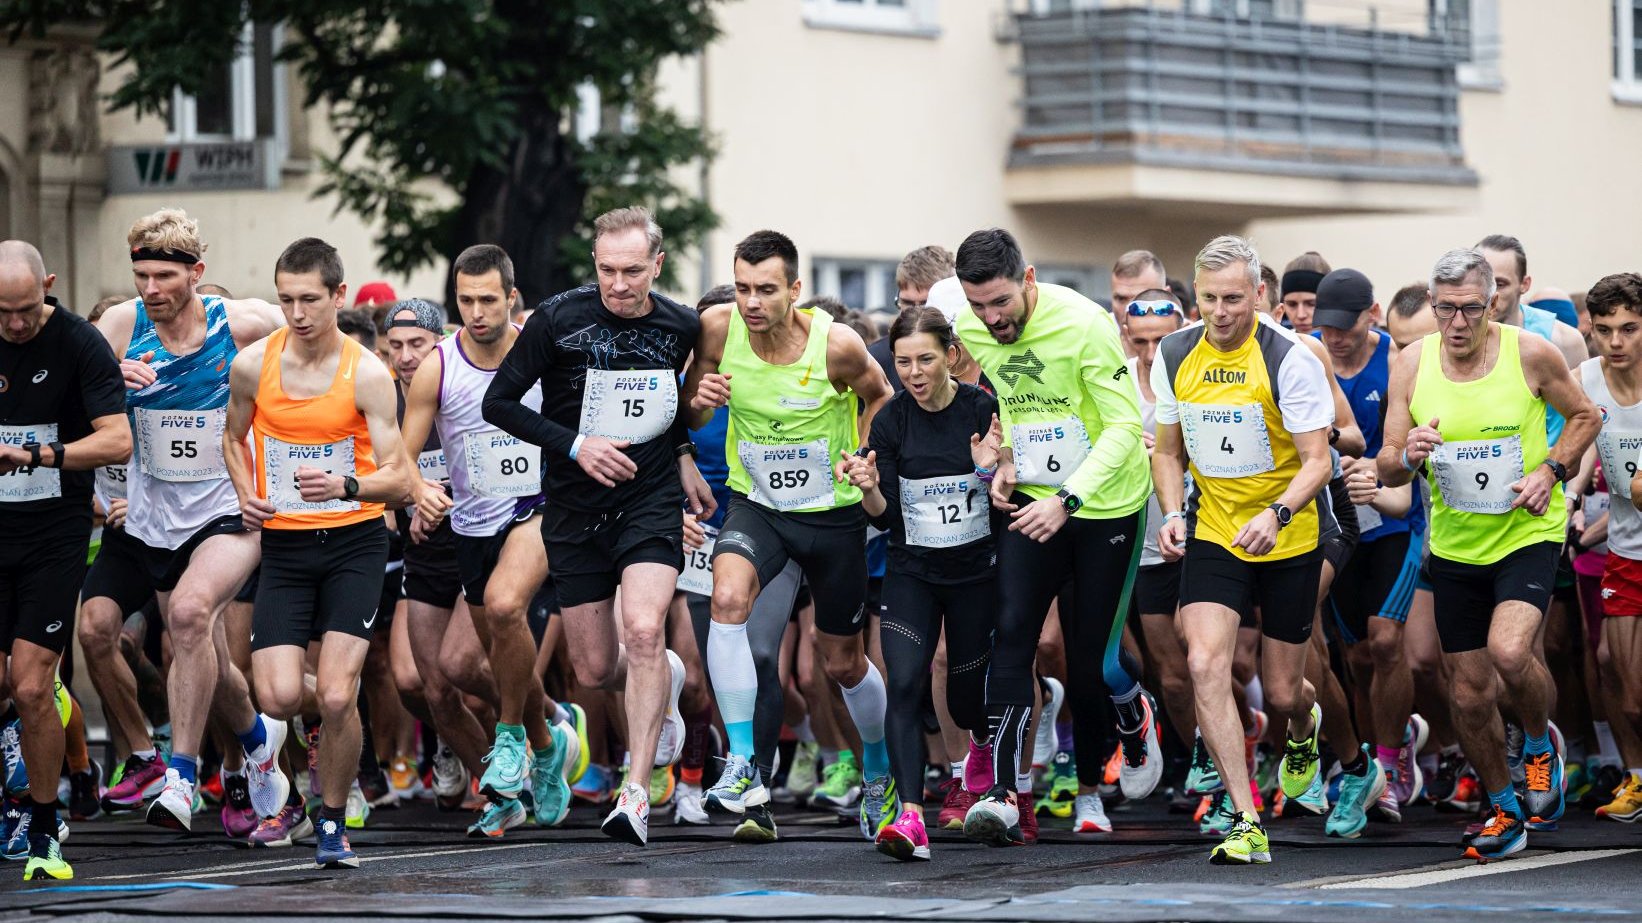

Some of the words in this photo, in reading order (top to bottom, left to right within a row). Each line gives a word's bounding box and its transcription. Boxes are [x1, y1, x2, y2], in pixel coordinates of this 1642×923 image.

[194, 147, 253, 168] WIPH
[614, 382, 647, 391] FIVE
[648, 377, 658, 391] 5
[622, 399, 645, 417] 15
[160, 420, 193, 428] FIVE
[195, 416, 206, 428] 5
[1202, 415, 1231, 423] FIVE
[1233, 411, 1242, 423] 5
[26, 431, 36, 443] 5
[1029, 433, 1052, 442] FIVE
[1054, 427, 1064, 439] 5
[170, 440, 198, 458] 55
[324, 444, 333, 457] 5
[491, 438, 520, 448] FIVE
[1220, 436, 1234, 454] 4
[764, 453, 796, 461] FIVE
[798, 448, 808, 459] 5
[1456, 451, 1489, 460] FIVE
[1491, 445, 1502, 457] 5
[500, 456, 529, 475] 80
[1047, 455, 1061, 472] 6
[1239, 463, 1260, 473] 2023
[106, 466, 128, 482] 53
[192, 467, 213, 477] 2023
[769, 469, 810, 489] 859
[924, 487, 956, 496] FIVE
[958, 481, 968, 492] 5
[1475, 472, 1489, 490] 9
[24, 486, 44, 497] 2023
[938, 504, 961, 525] 12
[960, 529, 978, 541] 2023
